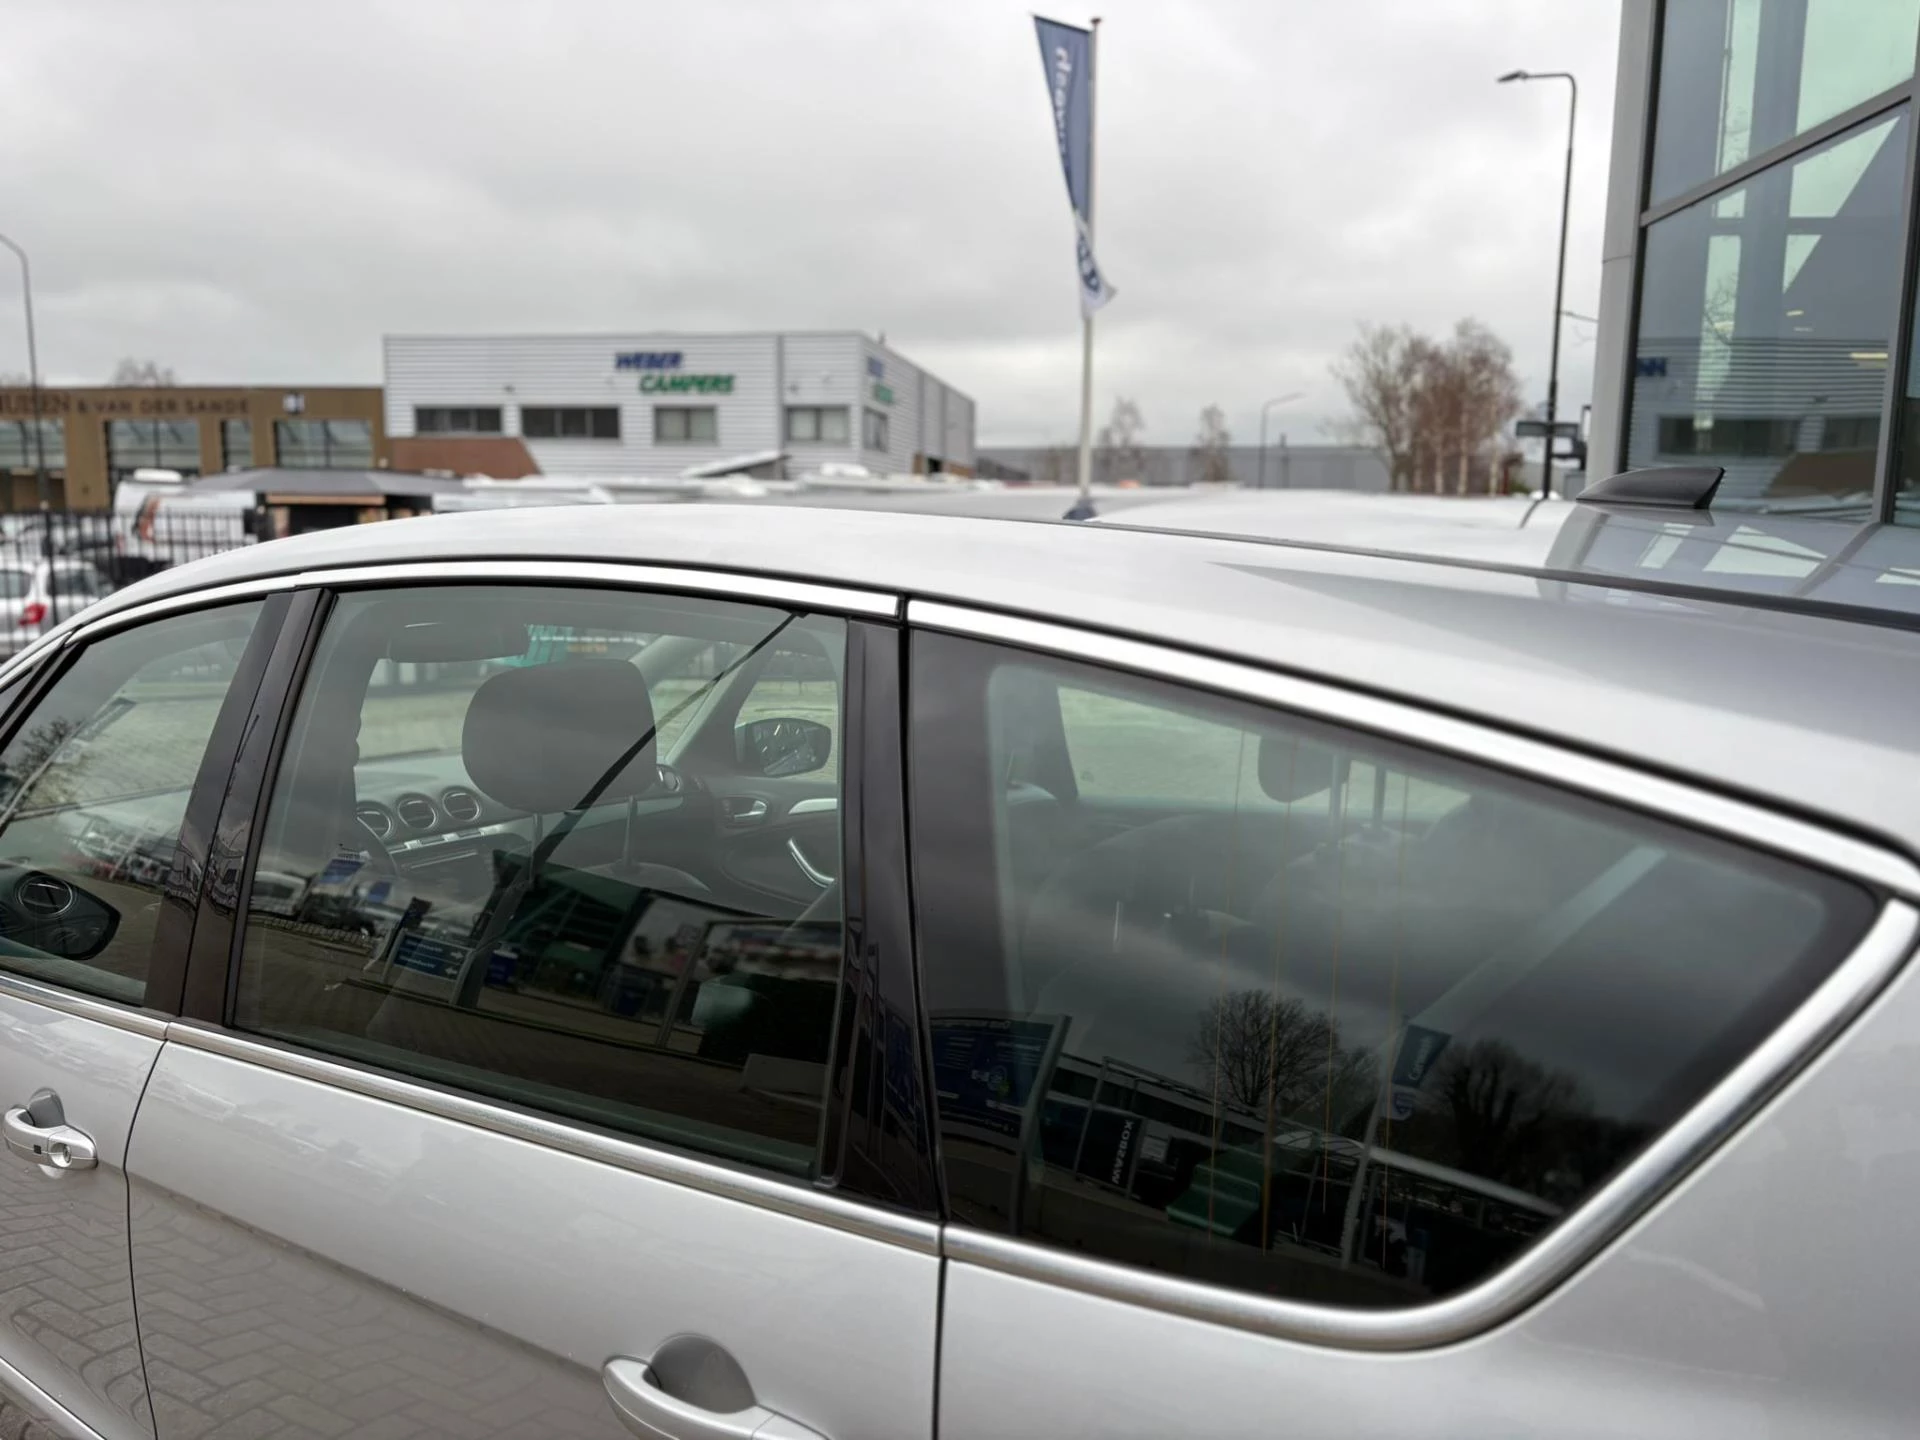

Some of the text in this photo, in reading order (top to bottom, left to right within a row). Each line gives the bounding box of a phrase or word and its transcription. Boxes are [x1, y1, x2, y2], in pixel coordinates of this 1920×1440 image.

[614, 351, 684, 370] WEBER
[639, 374, 736, 395] CAMPERS
[95, 399, 131, 413] VAN
[140, 398, 177, 414] DER
